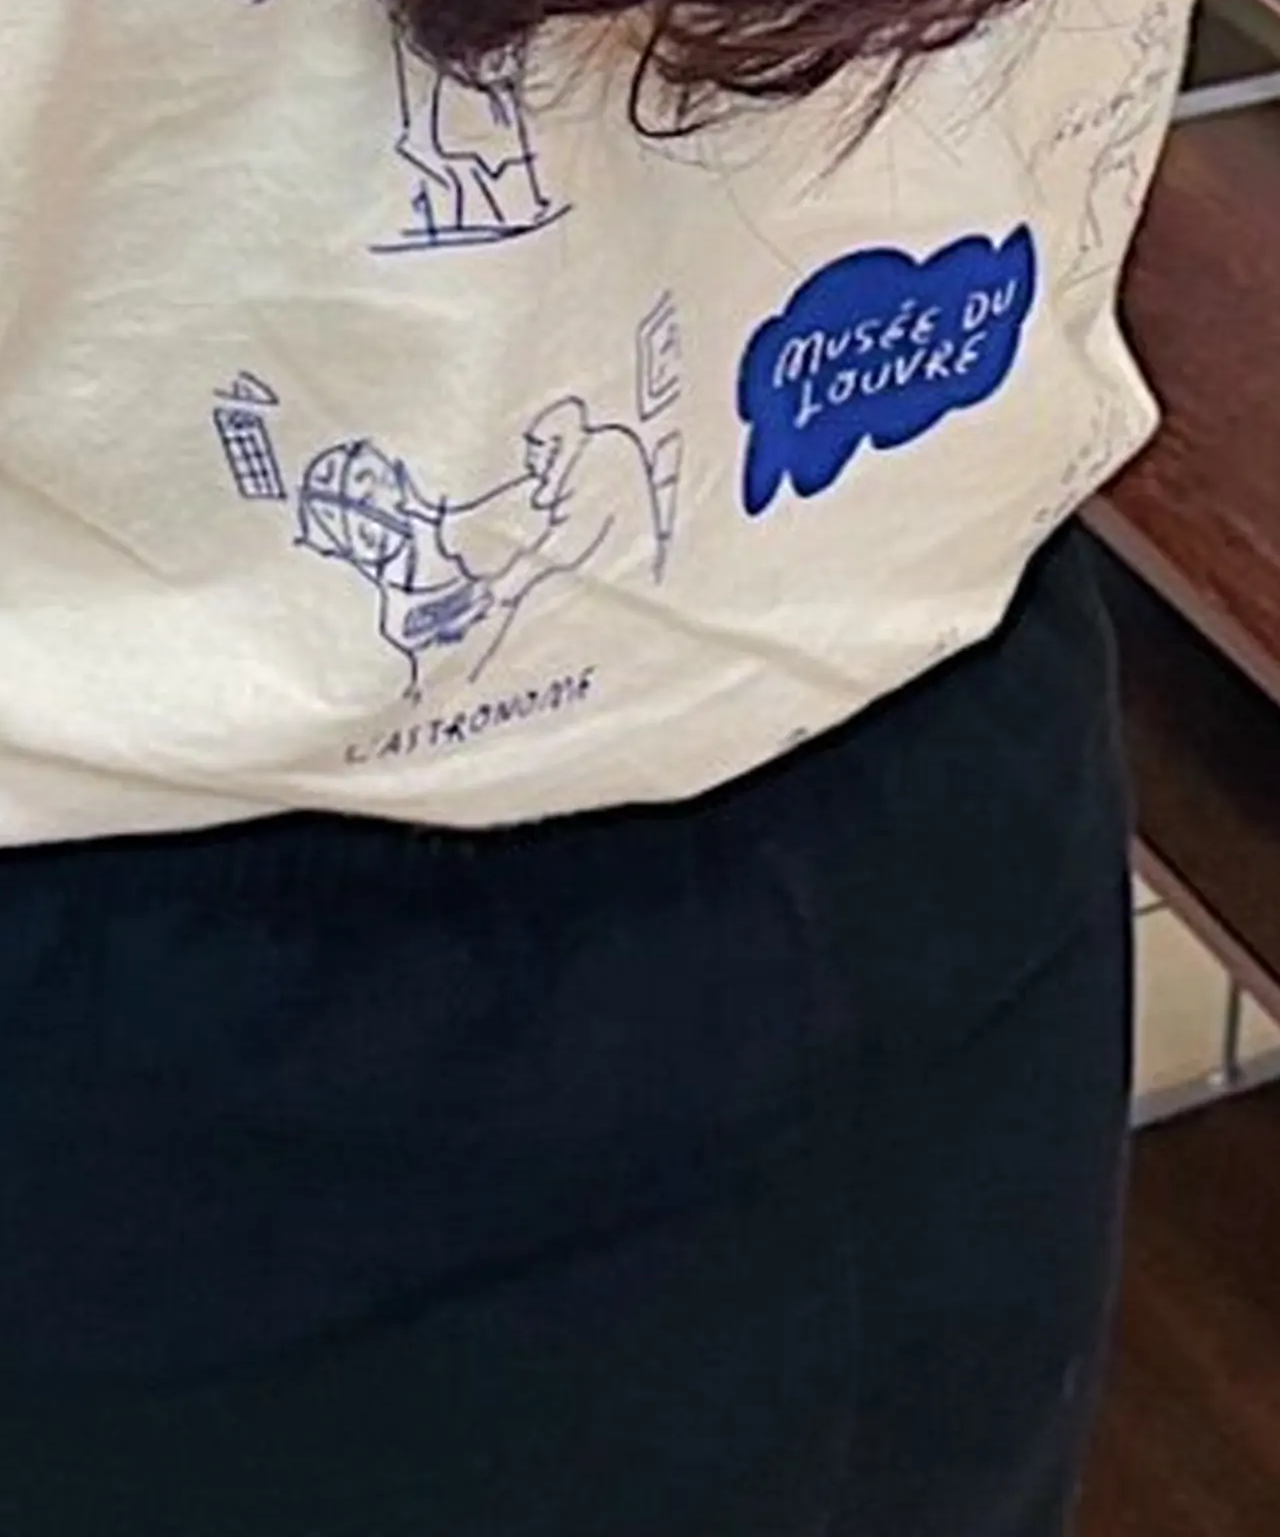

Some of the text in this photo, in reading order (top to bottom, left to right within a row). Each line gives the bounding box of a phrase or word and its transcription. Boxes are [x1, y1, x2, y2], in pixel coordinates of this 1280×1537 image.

[772, 279, 1017, 389] MUSÉE DU
[793, 330, 988, 430] LOUVRE
